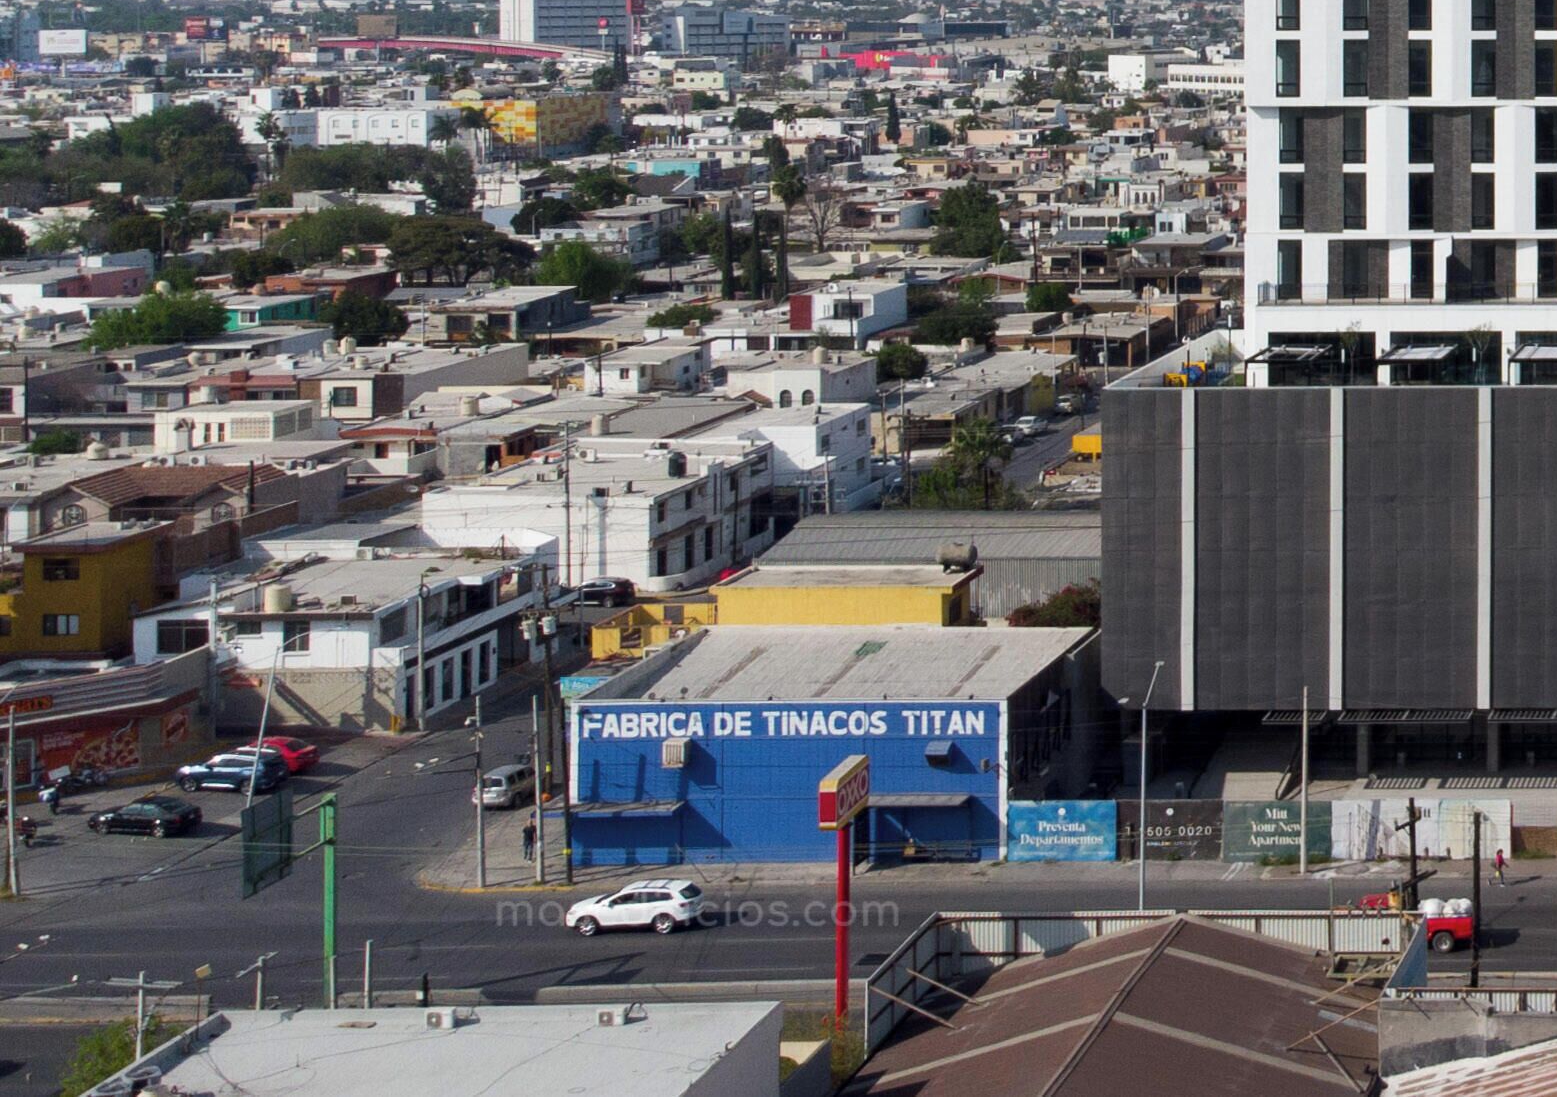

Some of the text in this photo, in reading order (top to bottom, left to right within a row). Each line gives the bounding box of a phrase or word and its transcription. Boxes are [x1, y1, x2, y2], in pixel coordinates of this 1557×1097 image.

[583, 710, 985, 738] FABRICA DE TINACOS TITAN
[838, 769, 868, 816] OXXO
[1178, 826, 1212, 836] 0020
